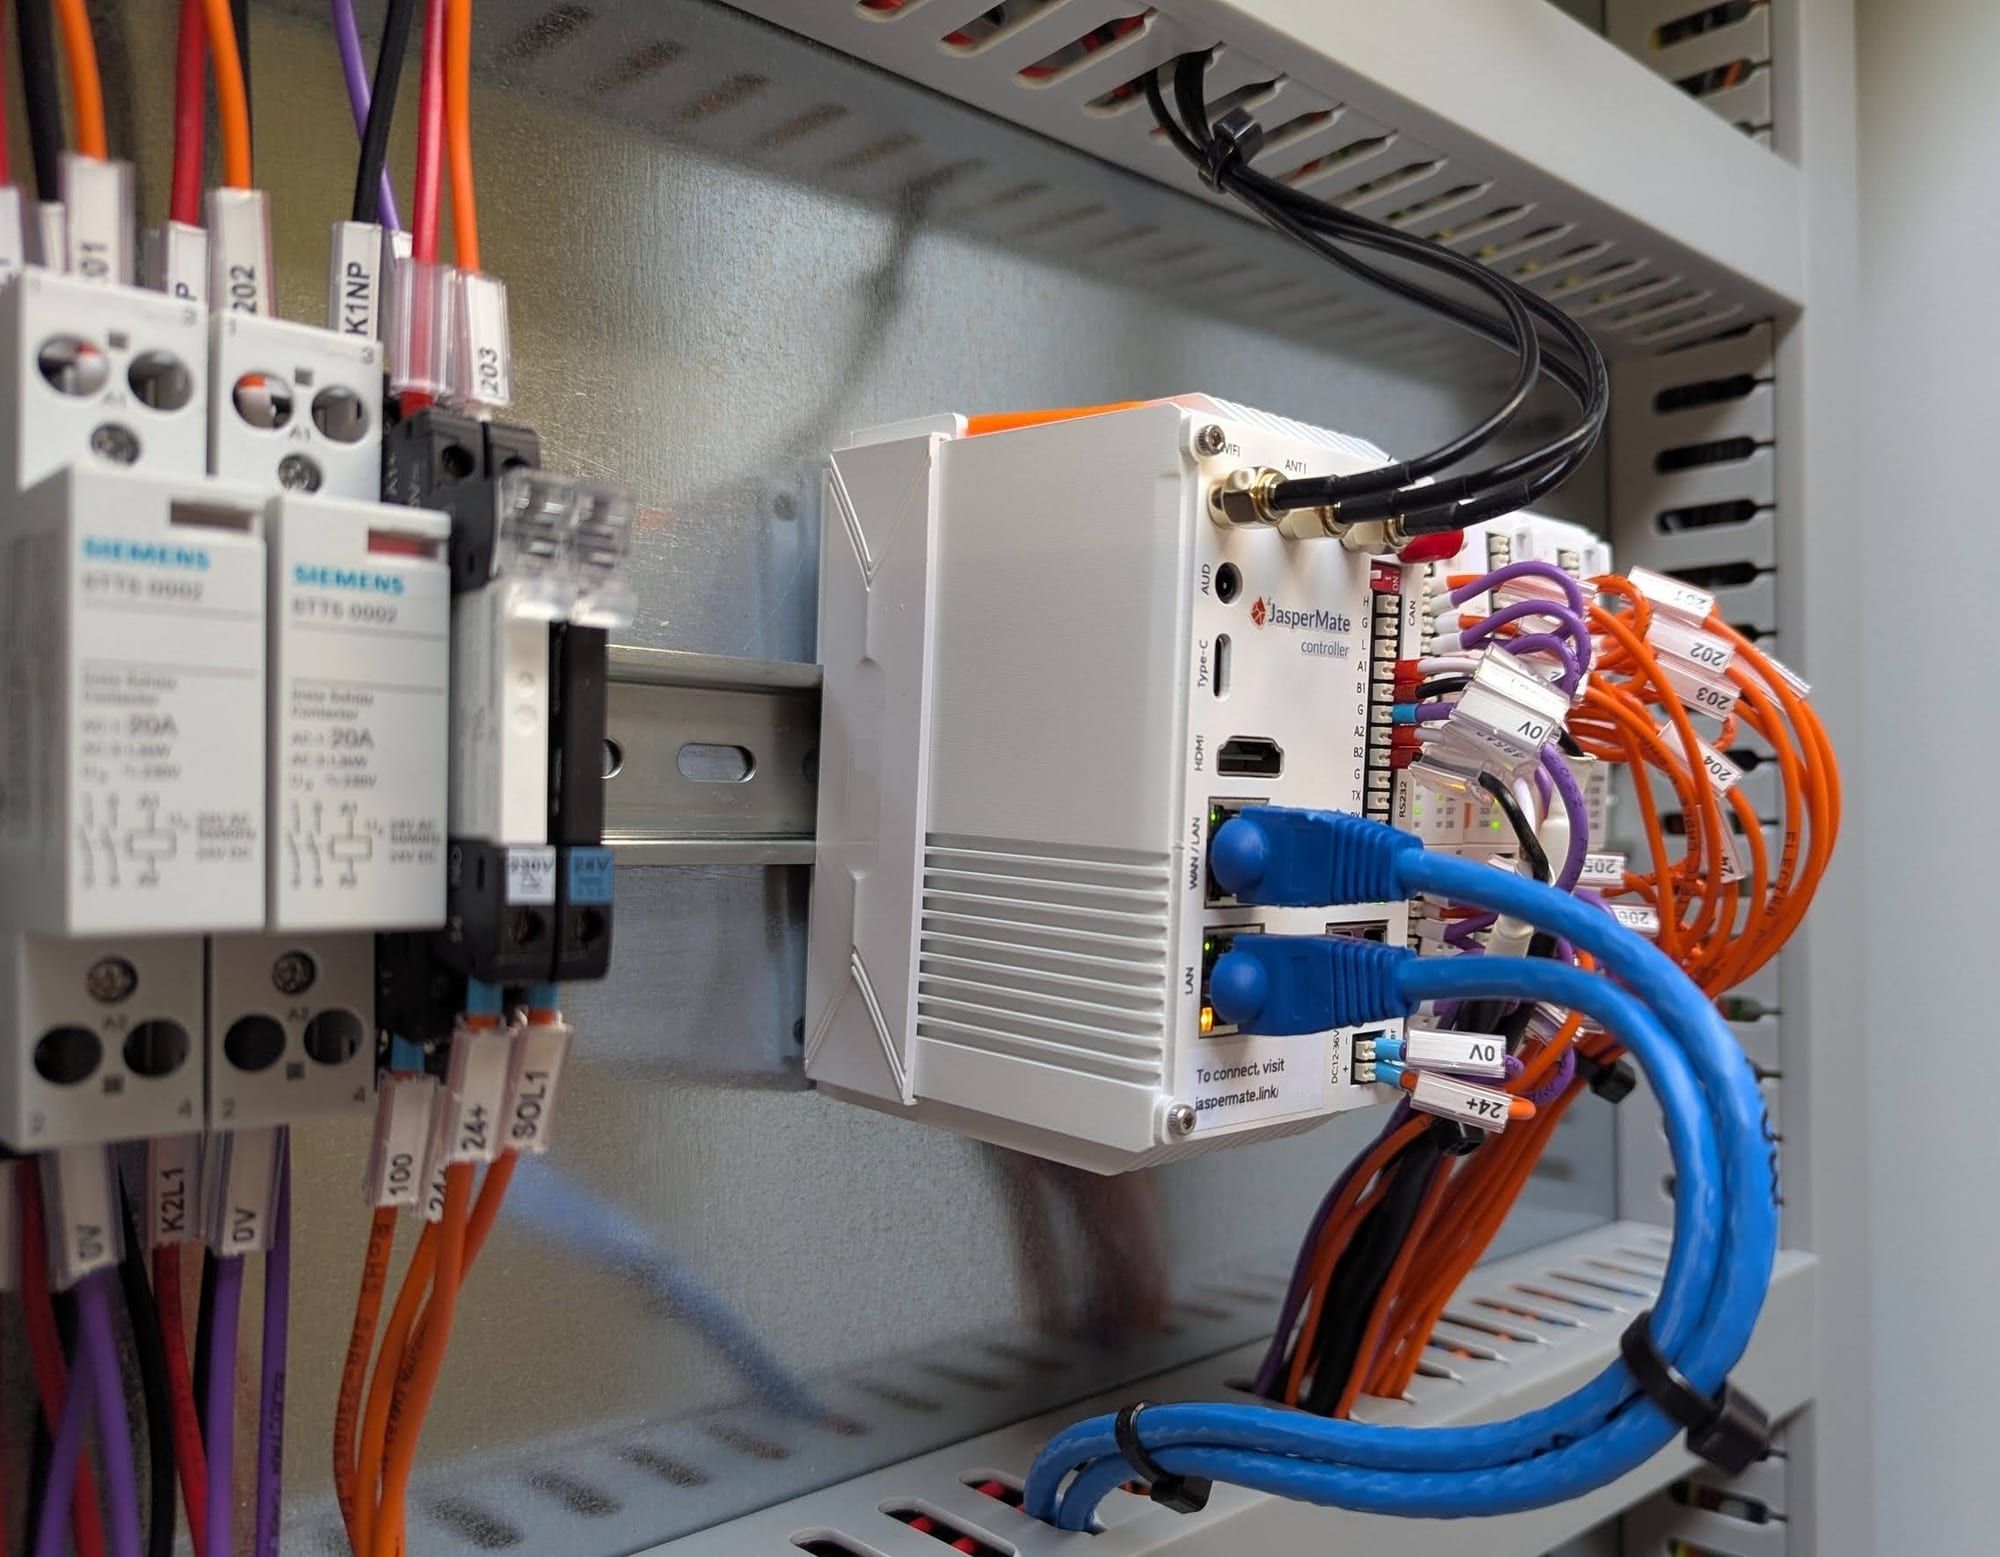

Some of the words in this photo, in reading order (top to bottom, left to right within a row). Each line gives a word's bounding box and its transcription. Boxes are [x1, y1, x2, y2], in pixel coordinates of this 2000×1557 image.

[229, 264, 257, 314] 202
[345, 261, 371, 336] K1NP
[479, 346, 499, 394] 203
[83, 536, 210, 571] SIEMENS
[294, 564, 406, 597] SIEMENS
[1201, 563, 1211, 595] AUD
[1362, 595, 1369, 608] H
[1408, 600, 1416, 627] CAN
[1268, 603, 1350, 633] JasperMate
[1361, 617, 1368, 629] G
[1301, 641, 1349, 658] controller
[1361, 640, 1366, 651] L
[1690, 642, 1726, 667] 202
[1197, 640, 1208, 688] Type-C
[1357, 661, 1367, 673] A1
[1356, 682, 1366, 694] B1
[1696, 687, 1730, 711] 203
[1357, 704, 1364, 716] G
[1354, 725, 1365, 738] A2
[1517, 721, 1543, 740] 0V
[1194, 735, 1205, 771] HDMI
[1353, 747, 1364, 759] B2
[1354, 768, 1361, 780] G
[1703, 755, 1731, 782] 204
[1352, 790, 1361, 801] TX
[1399, 781, 1408, 818] RS232
[1192, 816, 1200, 844] LAN
[1189, 857, 1199, 890] WAN
[1618, 911, 1650, 926] 206
[1185, 967, 1194, 995] LAN
[1469, 1044, 1495, 1062] 0V
[1196, 1068, 1211, 1084] To
[1213, 1061, 1260, 1081] connect,
[1262, 1057, 1285, 1074] visit
[1466, 1096, 1503, 1119] 24+
[461, 1104, 489, 1150] 24+
[388, 1153, 413, 1197] 100
[160, 1166, 185, 1233] K2L1
[233, 1206, 256, 1242] 0V
